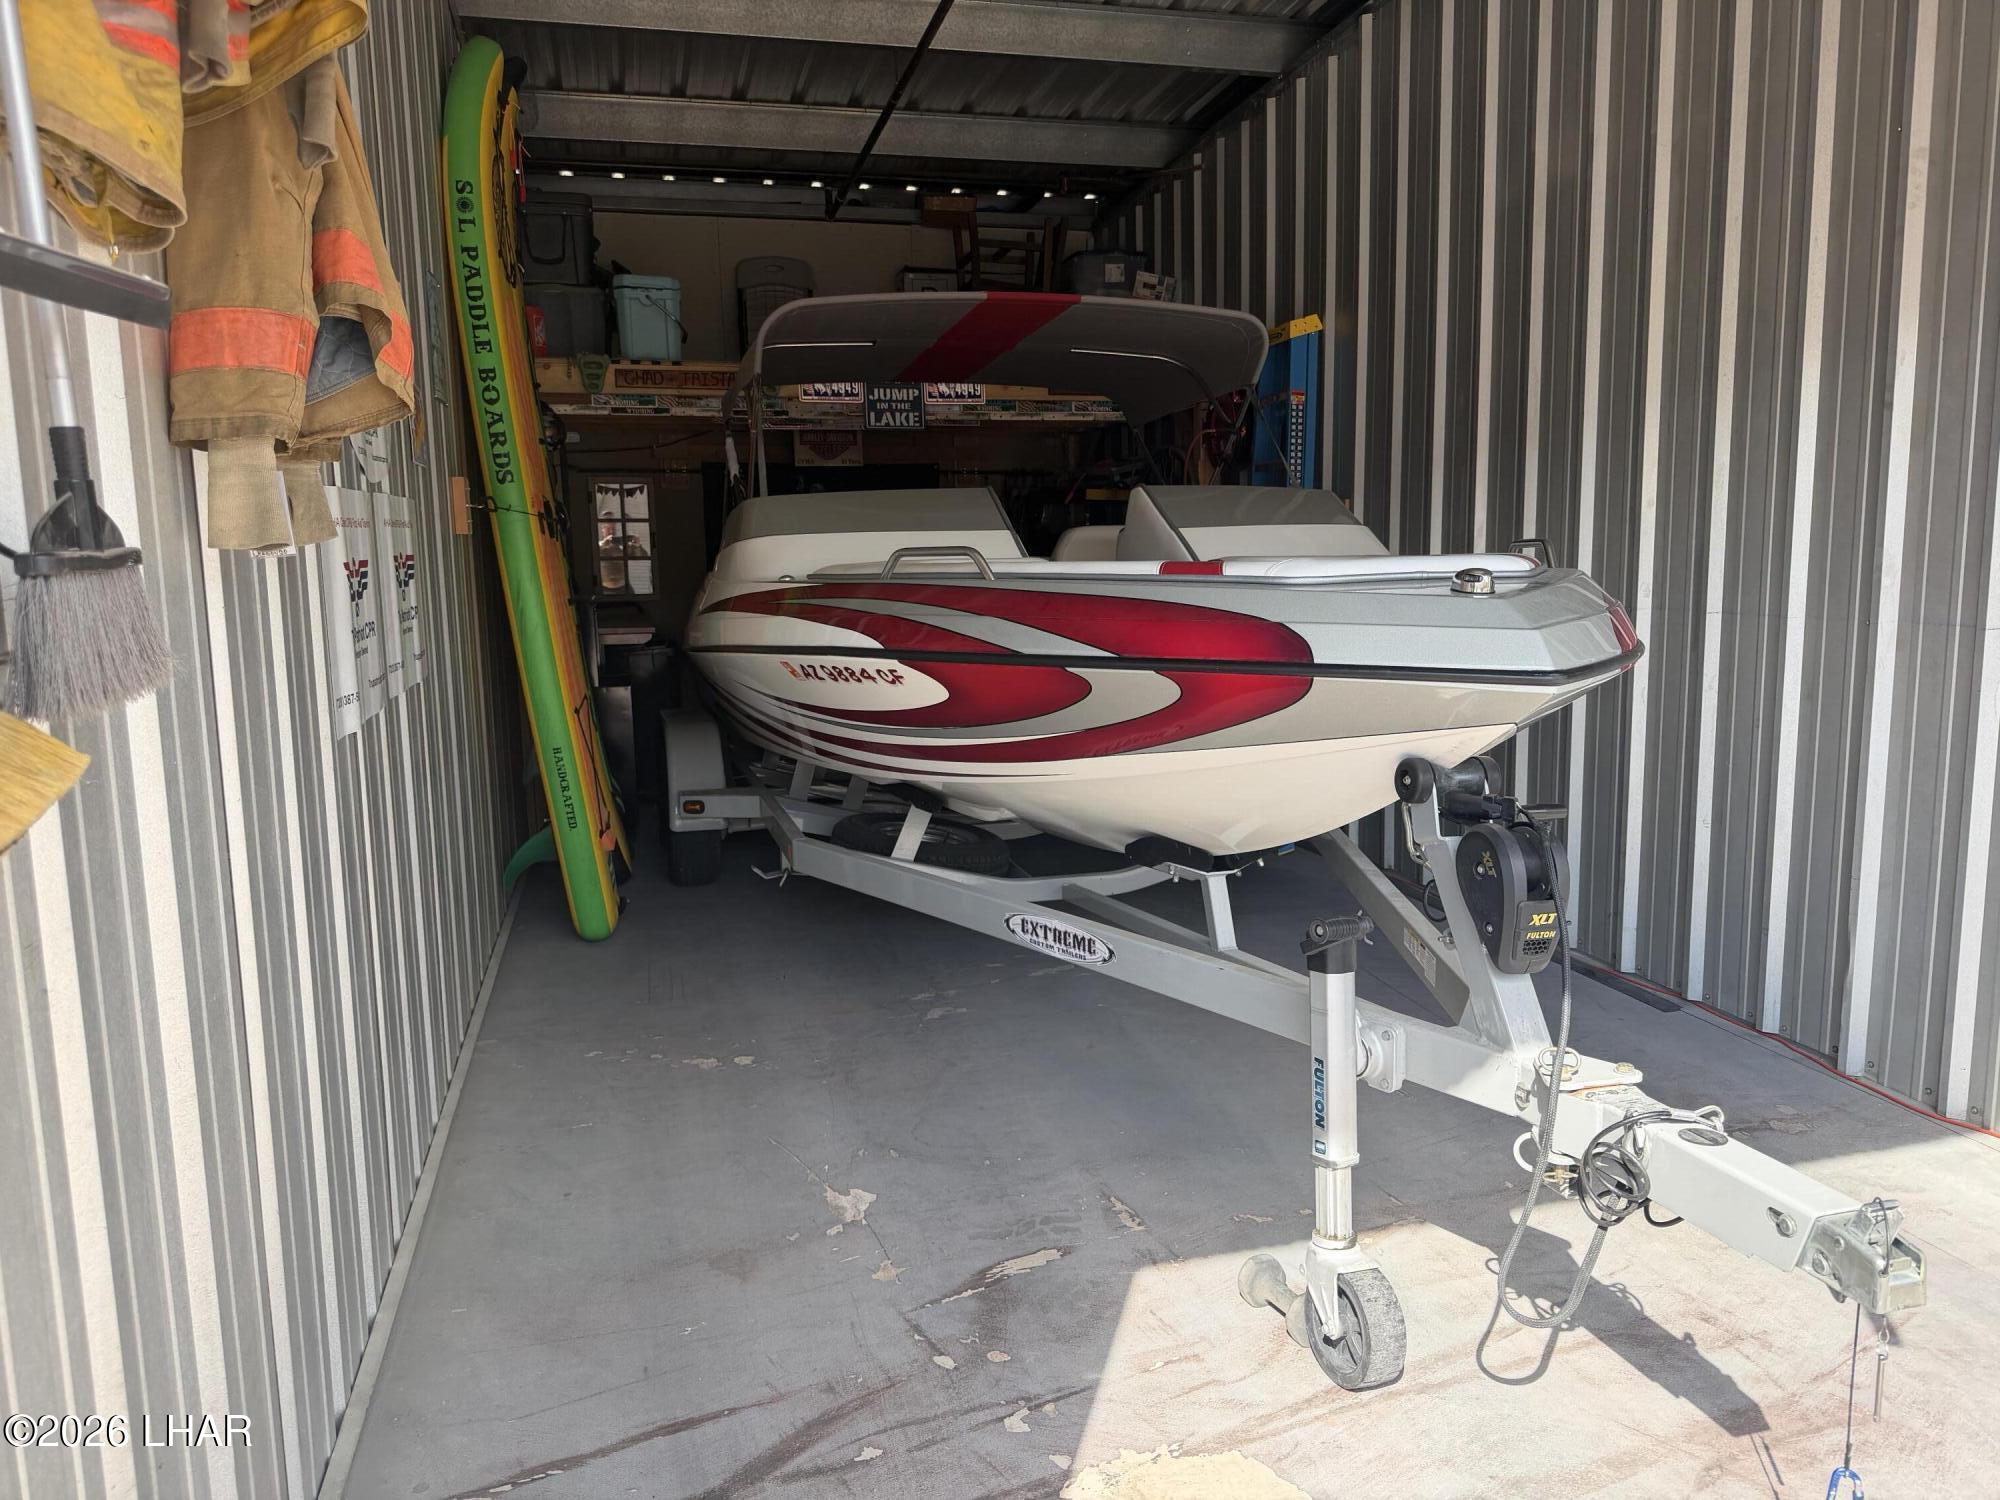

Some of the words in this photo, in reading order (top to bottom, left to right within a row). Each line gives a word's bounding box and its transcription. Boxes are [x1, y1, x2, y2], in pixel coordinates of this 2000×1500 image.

[460, 244, 493, 354] PADDLE
[478, 367, 514, 485] BOARDS
[624, 370, 664, 385] CHAD
[869, 388, 919, 401] JUMP
[876, 402, 891, 410] IN
[892, 402, 912, 410] THE
[870, 412, 920, 426] LAKE
[800, 663, 826, 681] AZ
[820, 665, 878, 684] 9884
[876, 669, 906, 686] CF
[1528, 912, 1558, 926] XLT
[1021, 917, 1097, 957] EXTREME
[1526, 930, 1557, 940] FULTON
[1029, 938, 1055, 951] CUSTOM
[1056, 946, 1087, 961] TRAILERS
[1314, 1056, 1326, 1129] FULTON
